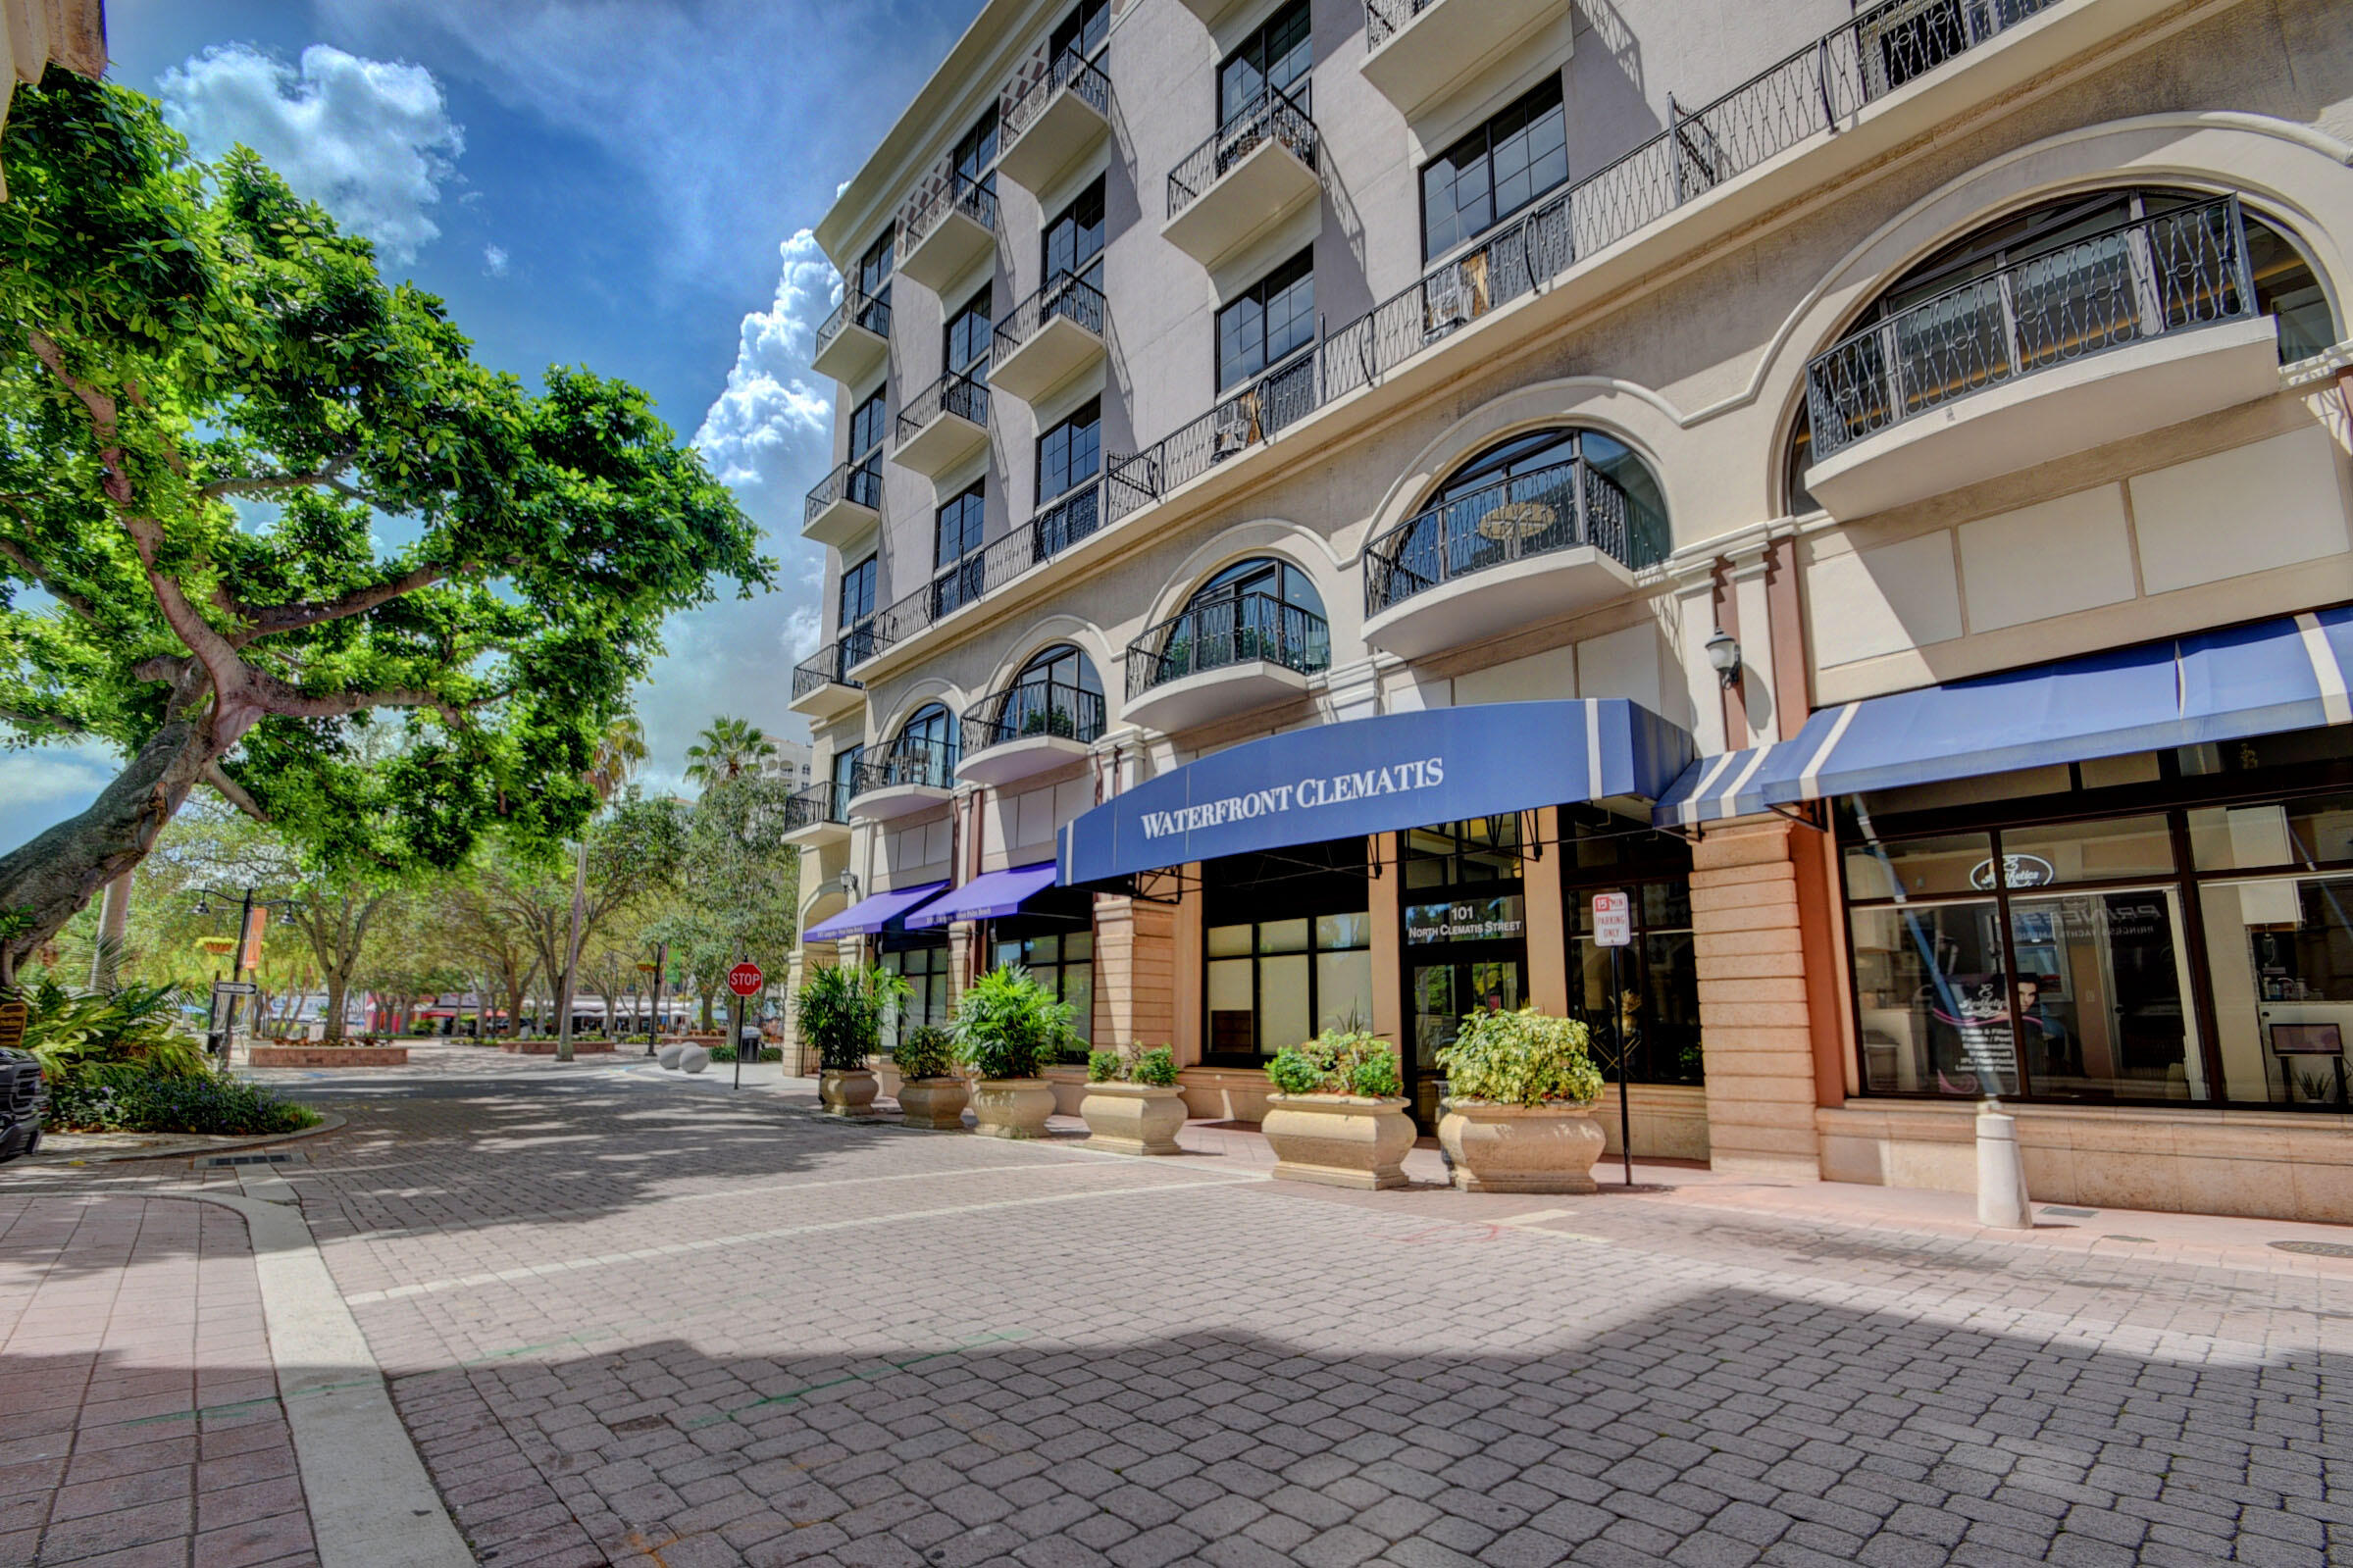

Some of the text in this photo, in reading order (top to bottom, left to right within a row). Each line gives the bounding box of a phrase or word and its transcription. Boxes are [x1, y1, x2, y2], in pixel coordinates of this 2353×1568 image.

[1141, 757, 1444, 839] WATERFRONT CLEMATIS
[1597, 899, 1608, 910] 15
[1452, 906, 1473, 921] 101
[1598, 916, 1624, 926] PARKING
[1408, 921, 1521, 938] NORTH CLEMATIS STREET
[1604, 929, 1619, 938] ONLY
[731, 973, 760, 986] STOP
